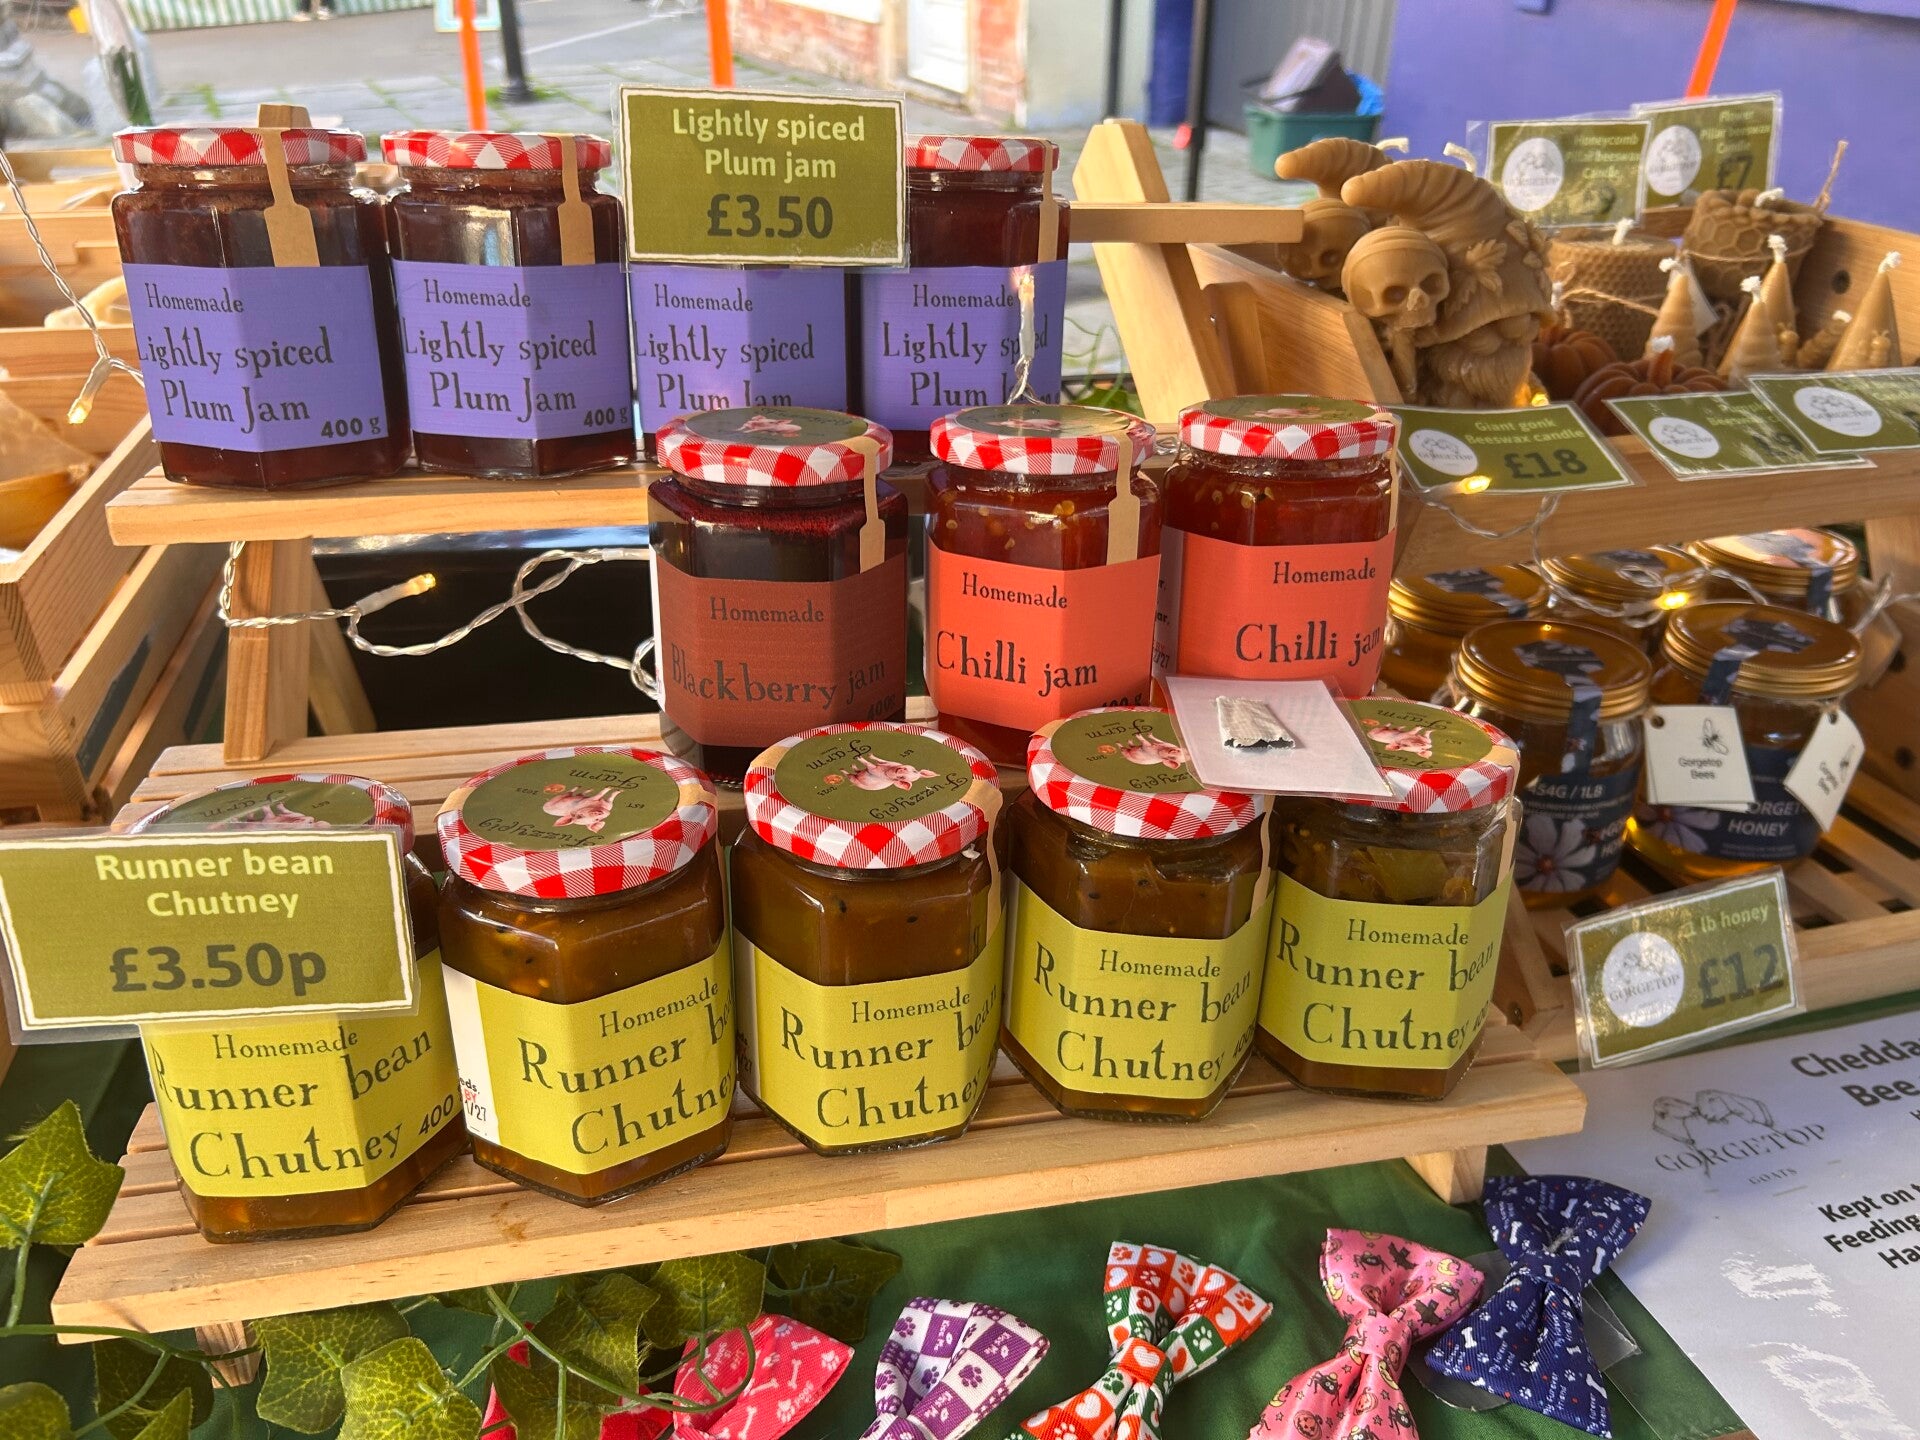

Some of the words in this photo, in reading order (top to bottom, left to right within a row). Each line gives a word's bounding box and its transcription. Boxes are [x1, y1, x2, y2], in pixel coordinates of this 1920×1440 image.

[672, 108, 769, 144] Lightly
[776, 113, 866, 143] spiced
[704, 149, 776, 177] Plum
[784, 153, 837, 183] jam
[706, 193, 834, 239] £3.50
[144, 282, 245, 313] Homemade
[423, 278, 532, 308] Homemade
[654, 283, 754, 313] Homemade
[912, 283, 1015, 309] Homemade
[134, 324, 222, 375] Lightly
[235, 326, 335, 379] spiced
[402, 317, 505, 367] Lightly
[519, 320, 597, 370] spiced
[634, 322, 727, 369] Lightly
[740, 324, 815, 373] spiced
[882, 322, 987, 365] Lightly
[1001, 314, 1048, 365] sped
[161, 379, 235, 423] Plum
[241, 386, 311, 434] Jam
[430, 371, 512, 413] Plum
[517, 377, 577, 423] Jam
[656, 373, 730, 409] Plum
[910, 372, 988, 406] Plum
[321, 417, 363, 439] 400
[583, 408, 616, 427] 400
[1474, 420, 1514, 432] Giant
[1519, 418, 1557, 433] gonk
[1465, 433, 1528, 444] Beeswax
[1533, 429, 1586, 443] candle
[1504, 447, 1588, 480] £18
[1273, 558, 1377, 585] Homemade
[962, 572, 1068, 609] Homemade
[709, 596, 825, 623] Homemade
[1236, 620, 1338, 664] Chilli
[1348, 627, 1380, 667] jam
[670, 643, 838, 710] Blackberry
[846, 660, 885, 705] jam
[936, 630, 1026, 684] Chilli
[1038, 660, 1099, 698] jam
[1085, 719, 1153, 739] Farm
[1378, 709, 1453, 731] Farm
[806, 738, 872, 771] Farm
[569, 767, 648, 790] Farm
[869, 772, 969, 821] Fuzzypig
[478, 817, 606, 849] Fuzzypig
[1727, 819, 1789, 837] HONEY
[95, 851, 231, 881] Runner
[243, 848, 334, 877] bean
[147, 891, 300, 918] Chutney
[1700, 915, 1717, 933] lb
[1720, 905, 1769, 928] honey
[1347, 919, 1470, 947] Homemade
[109, 942, 327, 997] £3.50p
[1099, 949, 1221, 979] Homemade
[1276, 917, 1425, 991] Runner
[1449, 941, 1494, 992] bean
[1033, 942, 1177, 1022] Runner
[1200, 972, 1250, 1024] bean
[1698, 944, 1785, 1009] £12
[600, 977, 720, 1038] Homemade
[852, 987, 971, 1024] Homemade
[213, 1026, 359, 1060] Homemade
[781, 1006, 934, 1071] Runner
[954, 984, 997, 1052] bean
[1302, 1001, 1470, 1052] Chutney
[151, 1043, 320, 1113] Runner
[339, 1030, 432, 1101] bean
[517, 1036, 688, 1095] Runner
[1057, 1031, 1225, 1083] Chutney
[1791, 1039, 1920, 1077] Chedda
[817, 1067, 981, 1130] Chutney
[1841, 1080, 1920, 1107] Bee
[189, 1121, 403, 1181] Chutney
[418, 1094, 455, 1138] 400
[1655, 1124, 1826, 1172] GORGETOP
[1749, 1167, 1798, 1185] GOATS
[1818, 1194, 1882, 1223] Kept
[1880, 1189, 1916, 1206] on
[1823, 1214, 1920, 1252] Feeding
[1877, 1245, 1920, 1269] Ha
